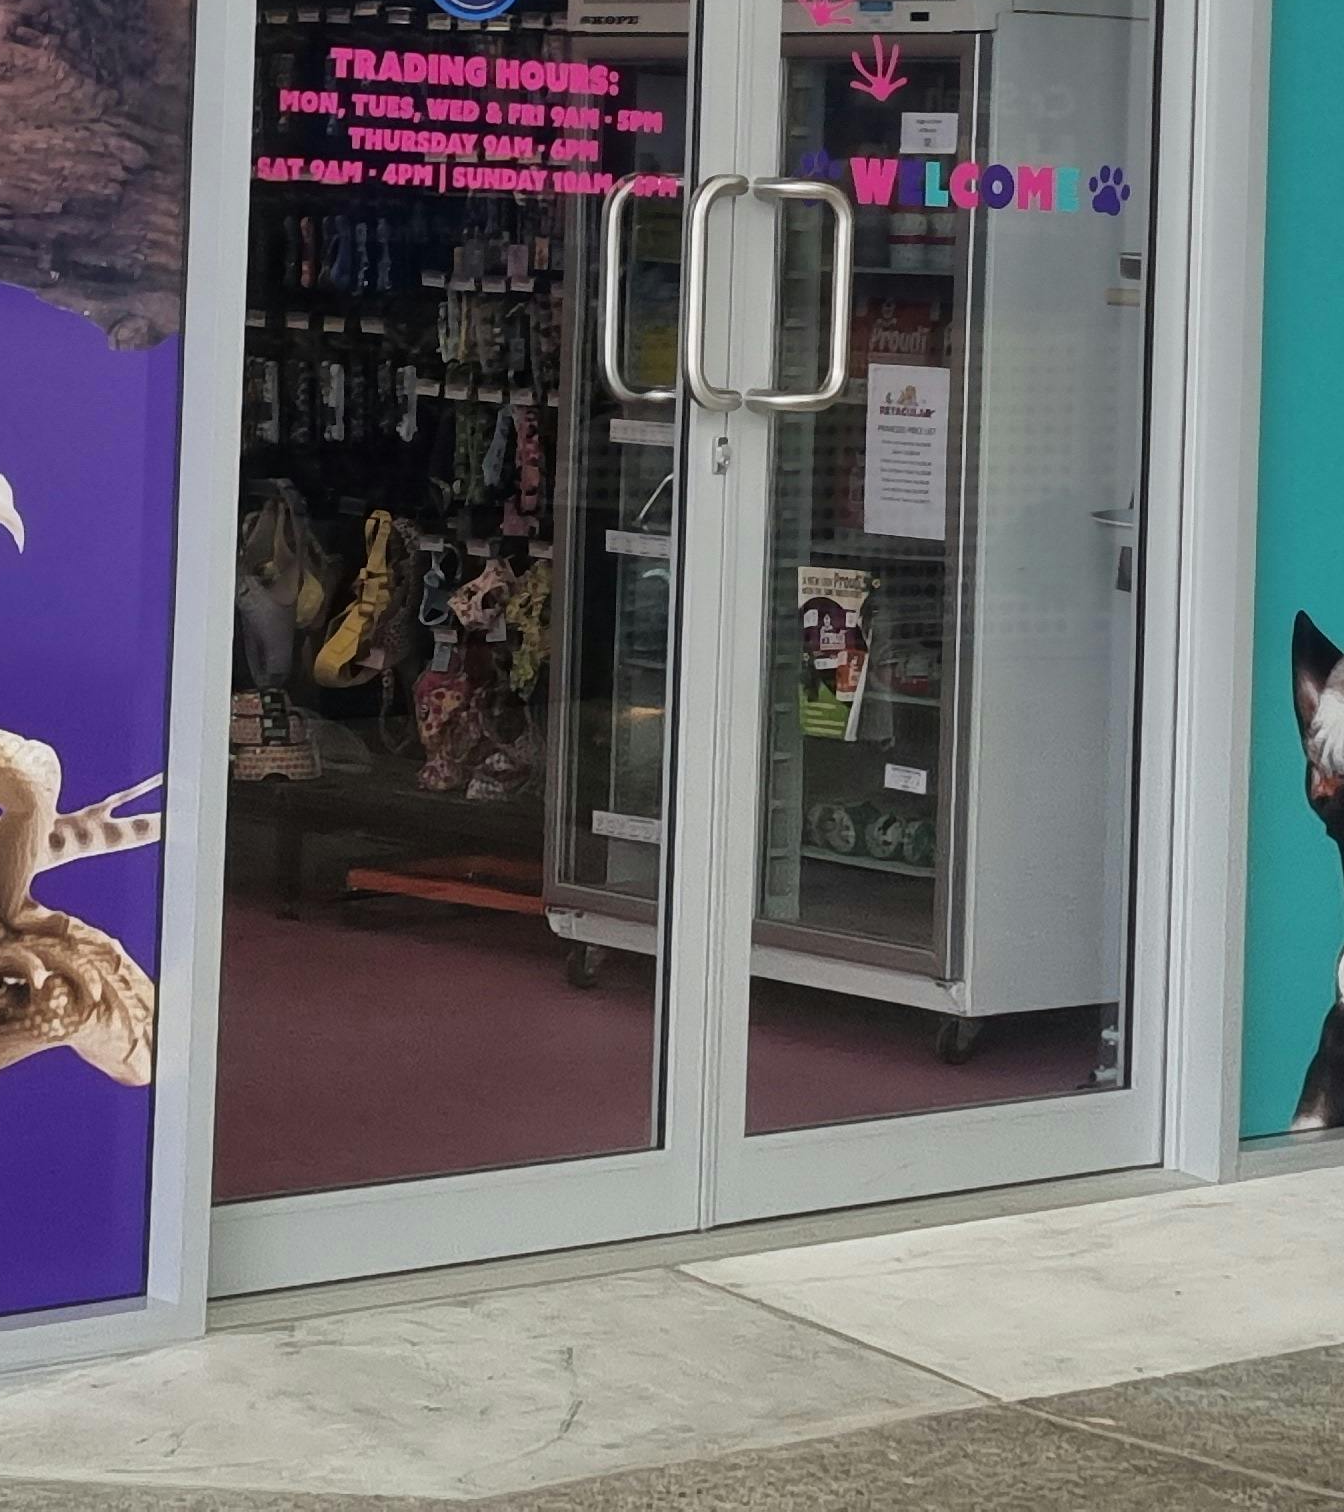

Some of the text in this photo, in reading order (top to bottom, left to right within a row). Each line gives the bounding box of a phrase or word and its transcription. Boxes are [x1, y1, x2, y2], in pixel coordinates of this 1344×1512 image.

[330, 47, 620, 96] TRADING HOURS:
[279, 89, 346, 119] MON,
[351, 93, 422, 123] TUES,
[426, 98, 481, 122] WED
[507, 102, 546, 126] FRI
[550, 105, 600, 129] 9AM
[616, 109, 663, 133] 5PM
[348, 127, 479, 155] THURSDAY
[482, 134, 534, 158] 9AM
[549, 138, 599, 162] 6PM
[257, 156, 305, 180] SAT
[309, 159, 363, 183] 9AM
[381, 163, 434, 186] 4PM
[452, 166, 549, 191] SUNDAY
[551, 170, 615, 194] 10AM
[849, 156, 1081, 214] WELCOME
